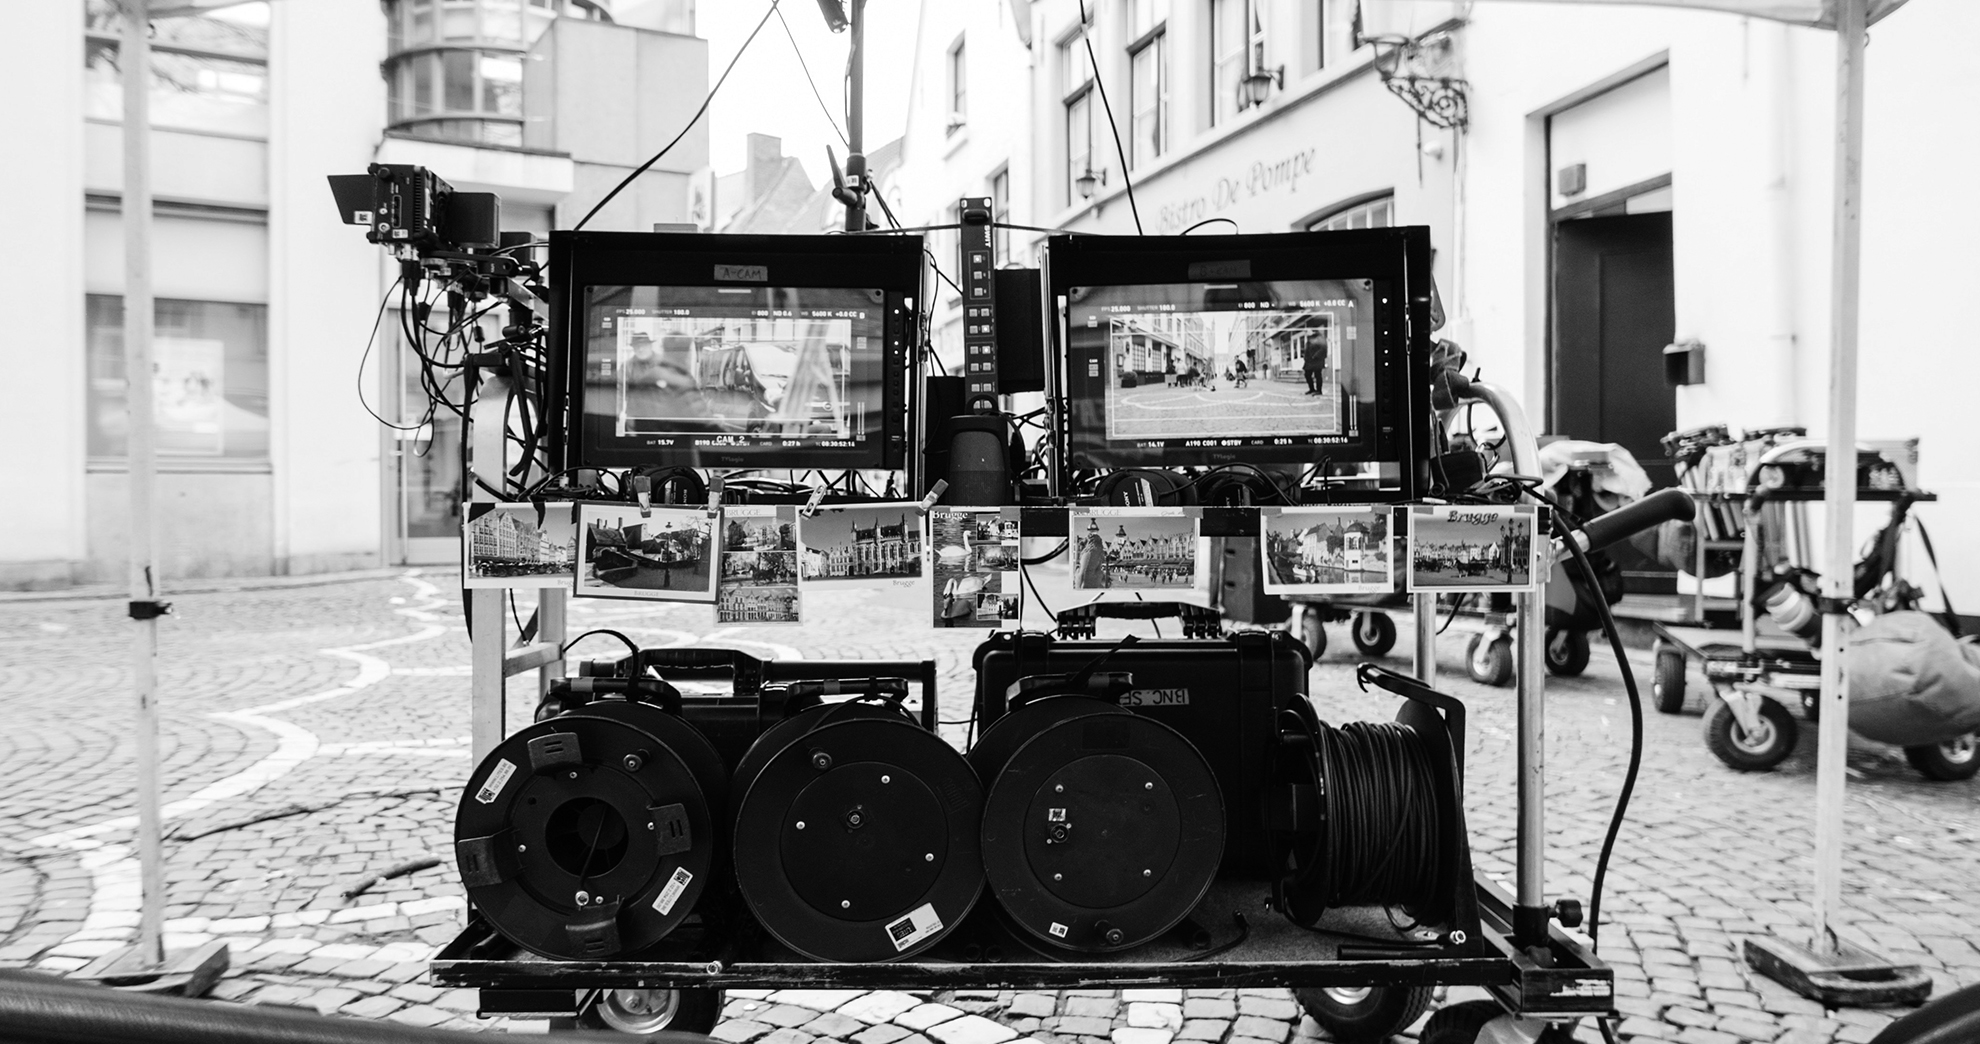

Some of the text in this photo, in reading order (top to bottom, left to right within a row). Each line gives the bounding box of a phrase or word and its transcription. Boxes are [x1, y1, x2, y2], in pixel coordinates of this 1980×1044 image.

[1155, 147, 1315, 235] Bistro De Pompe
[723, 267, 762, 280] A-CAM
[1348, 300, 1354, 308] A
[739, 436, 745, 444] 2
[933, 511, 968, 520] Brugge
[1447, 510, 1499, 526] Brugge
[557, 579, 574, 588] Brug
[892, 580, 915, 588] Brugge
[1358, 584, 1381, 593] Brugge
